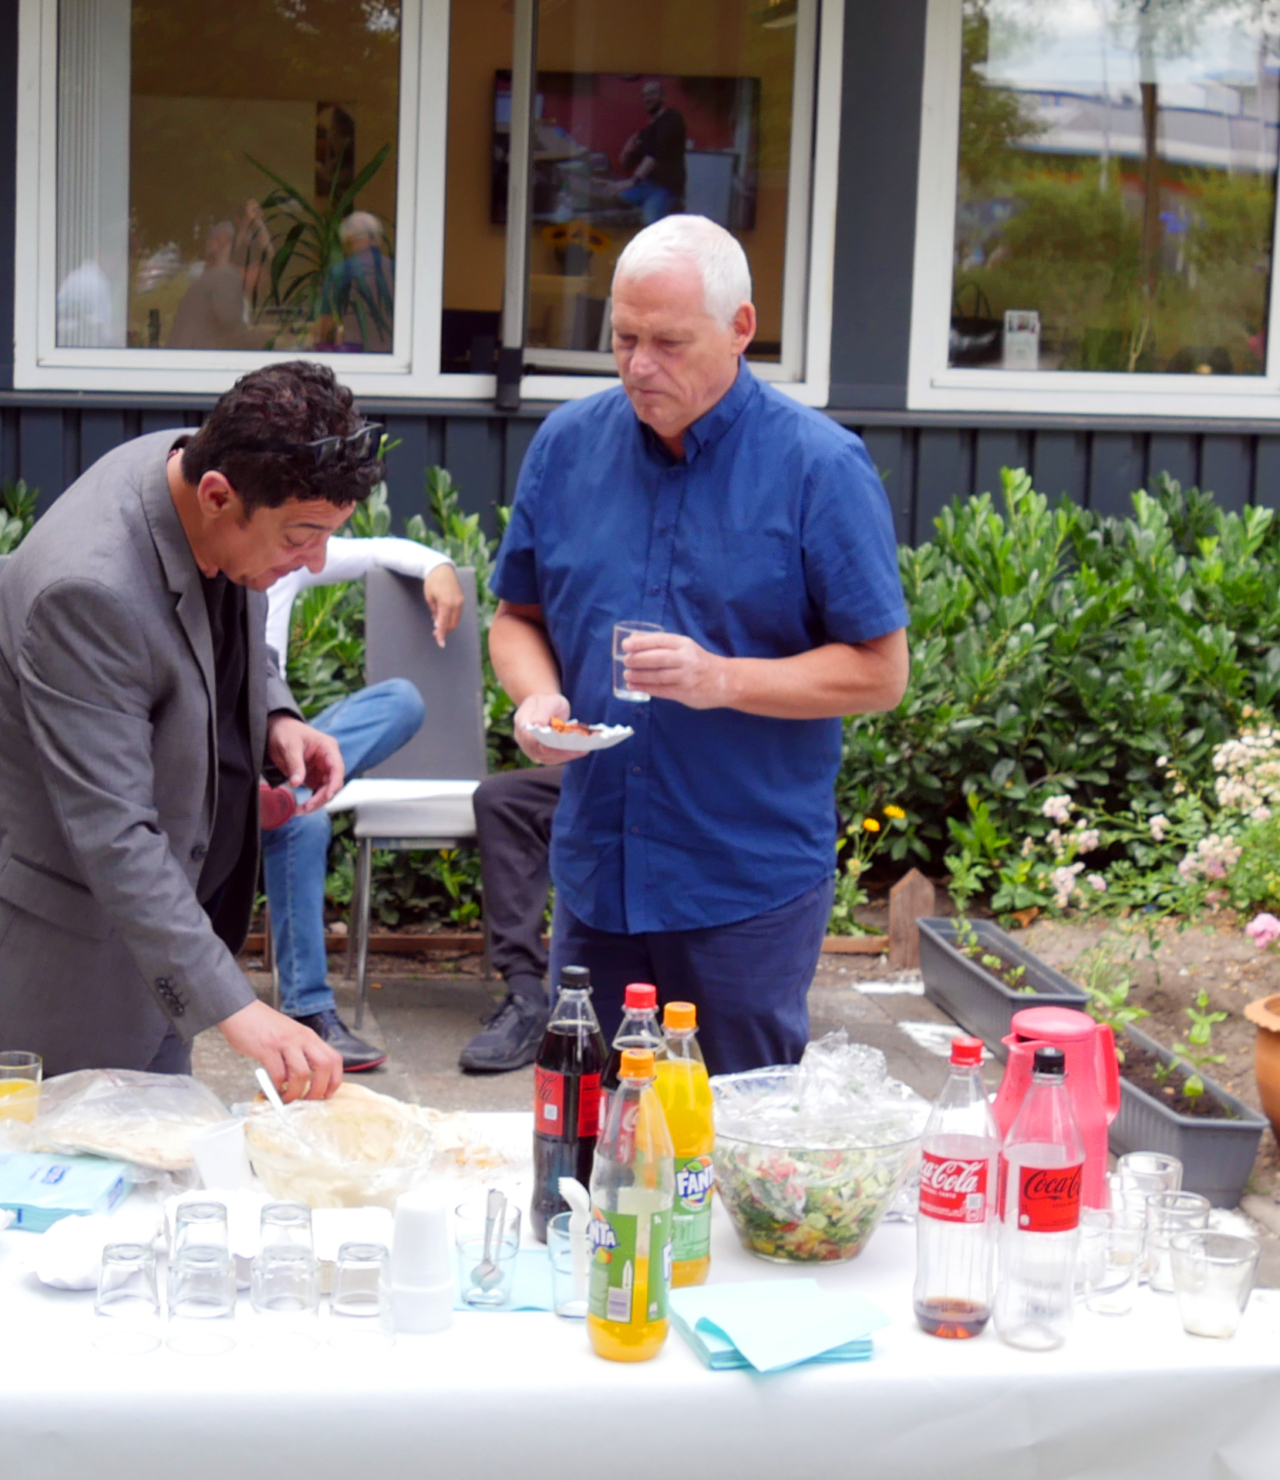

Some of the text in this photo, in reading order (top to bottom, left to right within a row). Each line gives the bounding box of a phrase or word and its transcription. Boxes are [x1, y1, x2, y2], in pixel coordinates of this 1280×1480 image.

[676, 1164, 714, 1196] FANT
[922, 1159, 985, 1193] a-Cola
[1024, 1165, 1082, 1200] Coca-C
[589, 1219, 617, 1247] NTA
